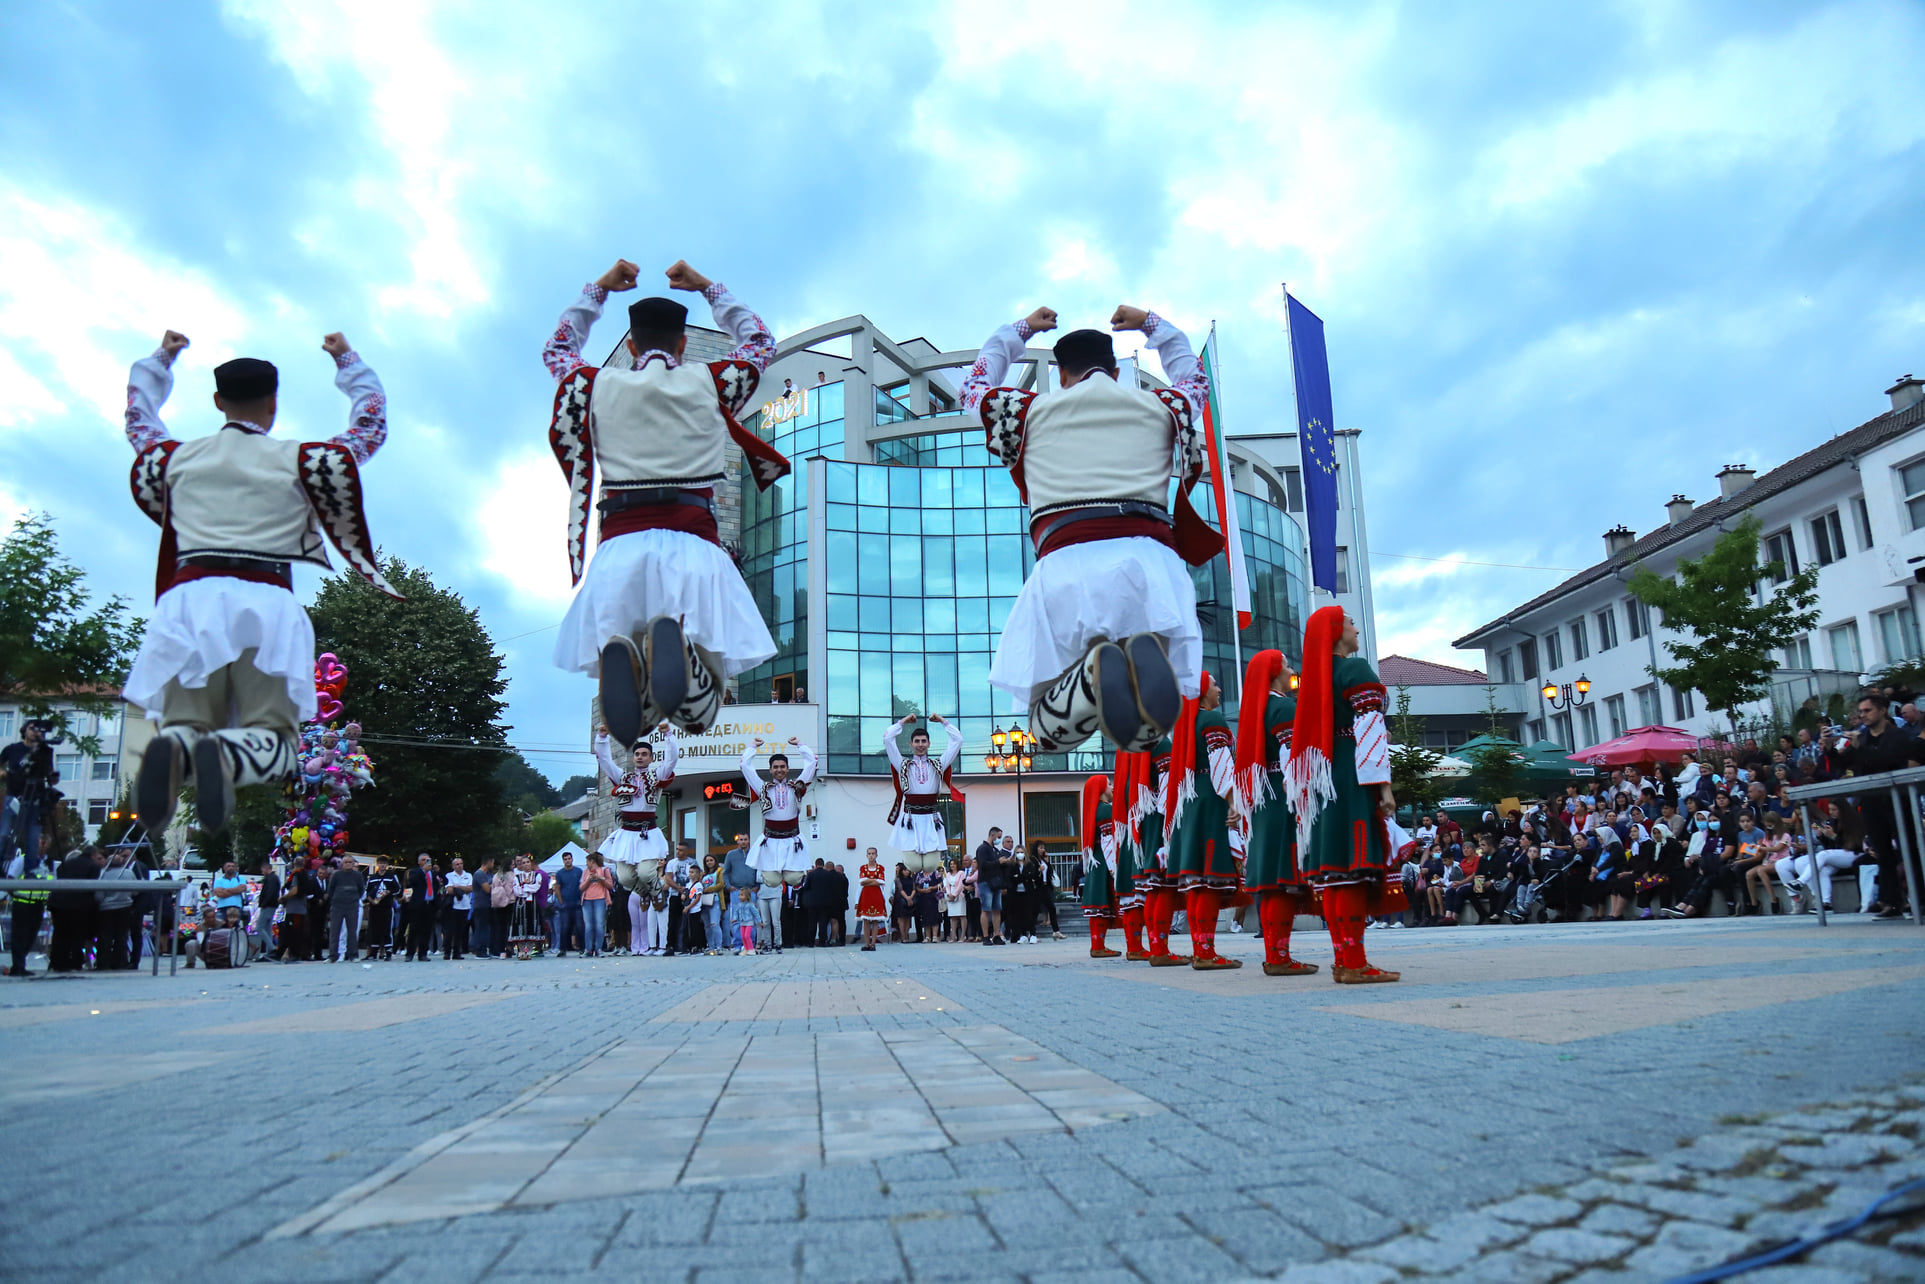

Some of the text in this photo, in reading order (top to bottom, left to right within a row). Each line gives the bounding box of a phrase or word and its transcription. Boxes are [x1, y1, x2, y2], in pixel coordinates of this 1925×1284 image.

[761, 388, 808, 430] 2021
[696, 722, 775, 738] ЕДЕЛИНО
[688, 742, 788, 757] MUNICIPLITY
